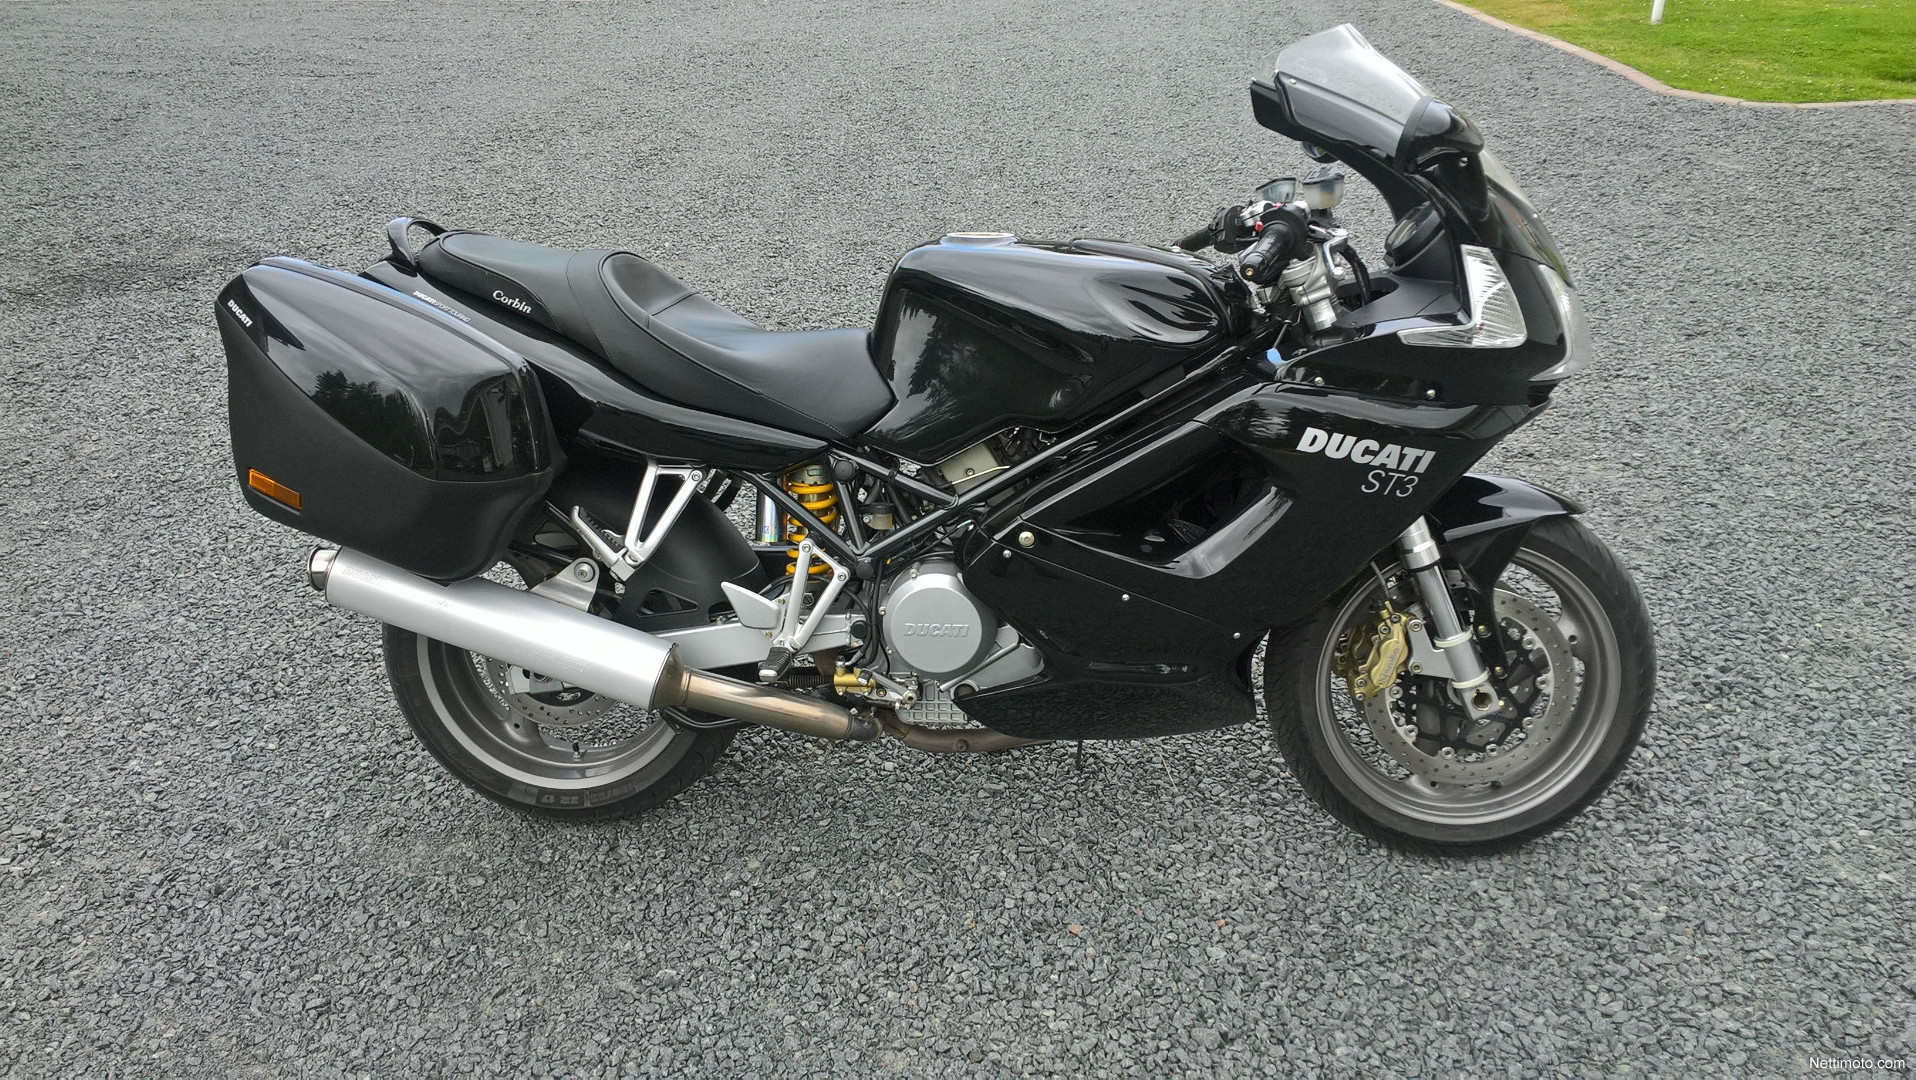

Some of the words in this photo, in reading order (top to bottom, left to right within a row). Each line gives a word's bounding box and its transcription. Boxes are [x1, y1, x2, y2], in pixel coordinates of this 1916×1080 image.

[227, 299, 253, 328] DUCATI
[492, 290, 532, 314] Corbin
[1296, 426, 1436, 474] DUCATI
[1361, 469, 1419, 498] ST3
[342, 564, 385, 587] DUCA
[904, 622, 970, 638] DUCATI
